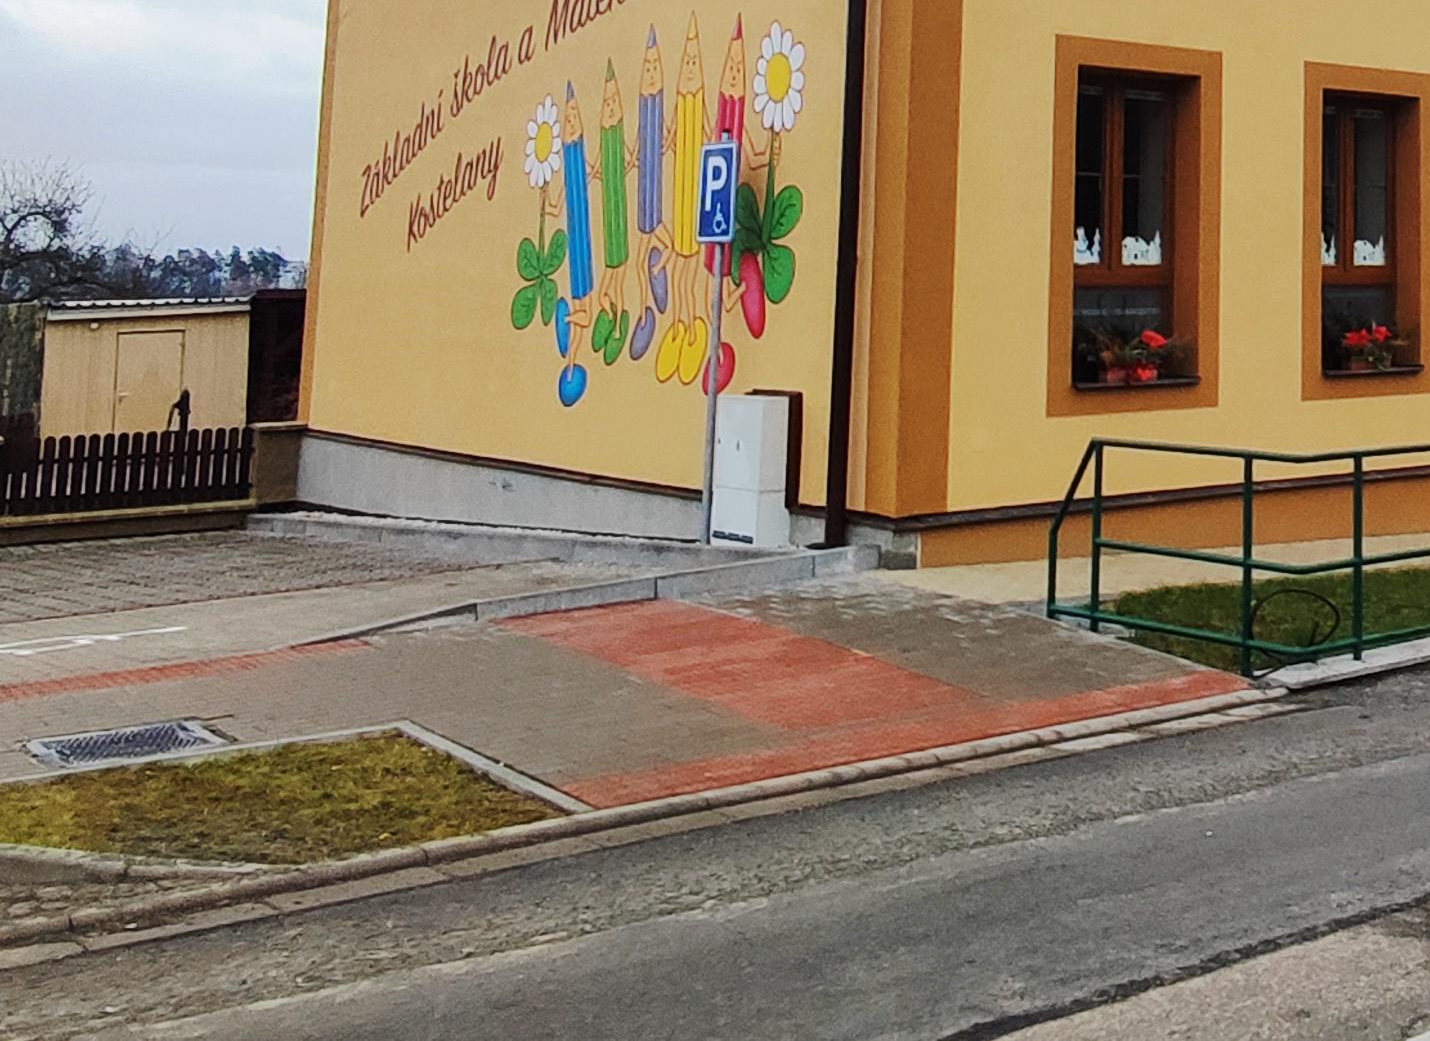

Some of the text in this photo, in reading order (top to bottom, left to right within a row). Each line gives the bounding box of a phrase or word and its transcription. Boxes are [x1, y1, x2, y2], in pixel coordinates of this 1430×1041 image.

[359, 88, 446, 219] Základní
[450, 34, 514, 118] škola
[517, 25, 536, 65] a
[406, 136, 504, 254] Kostelany
[705, 155, 728, 212] P
